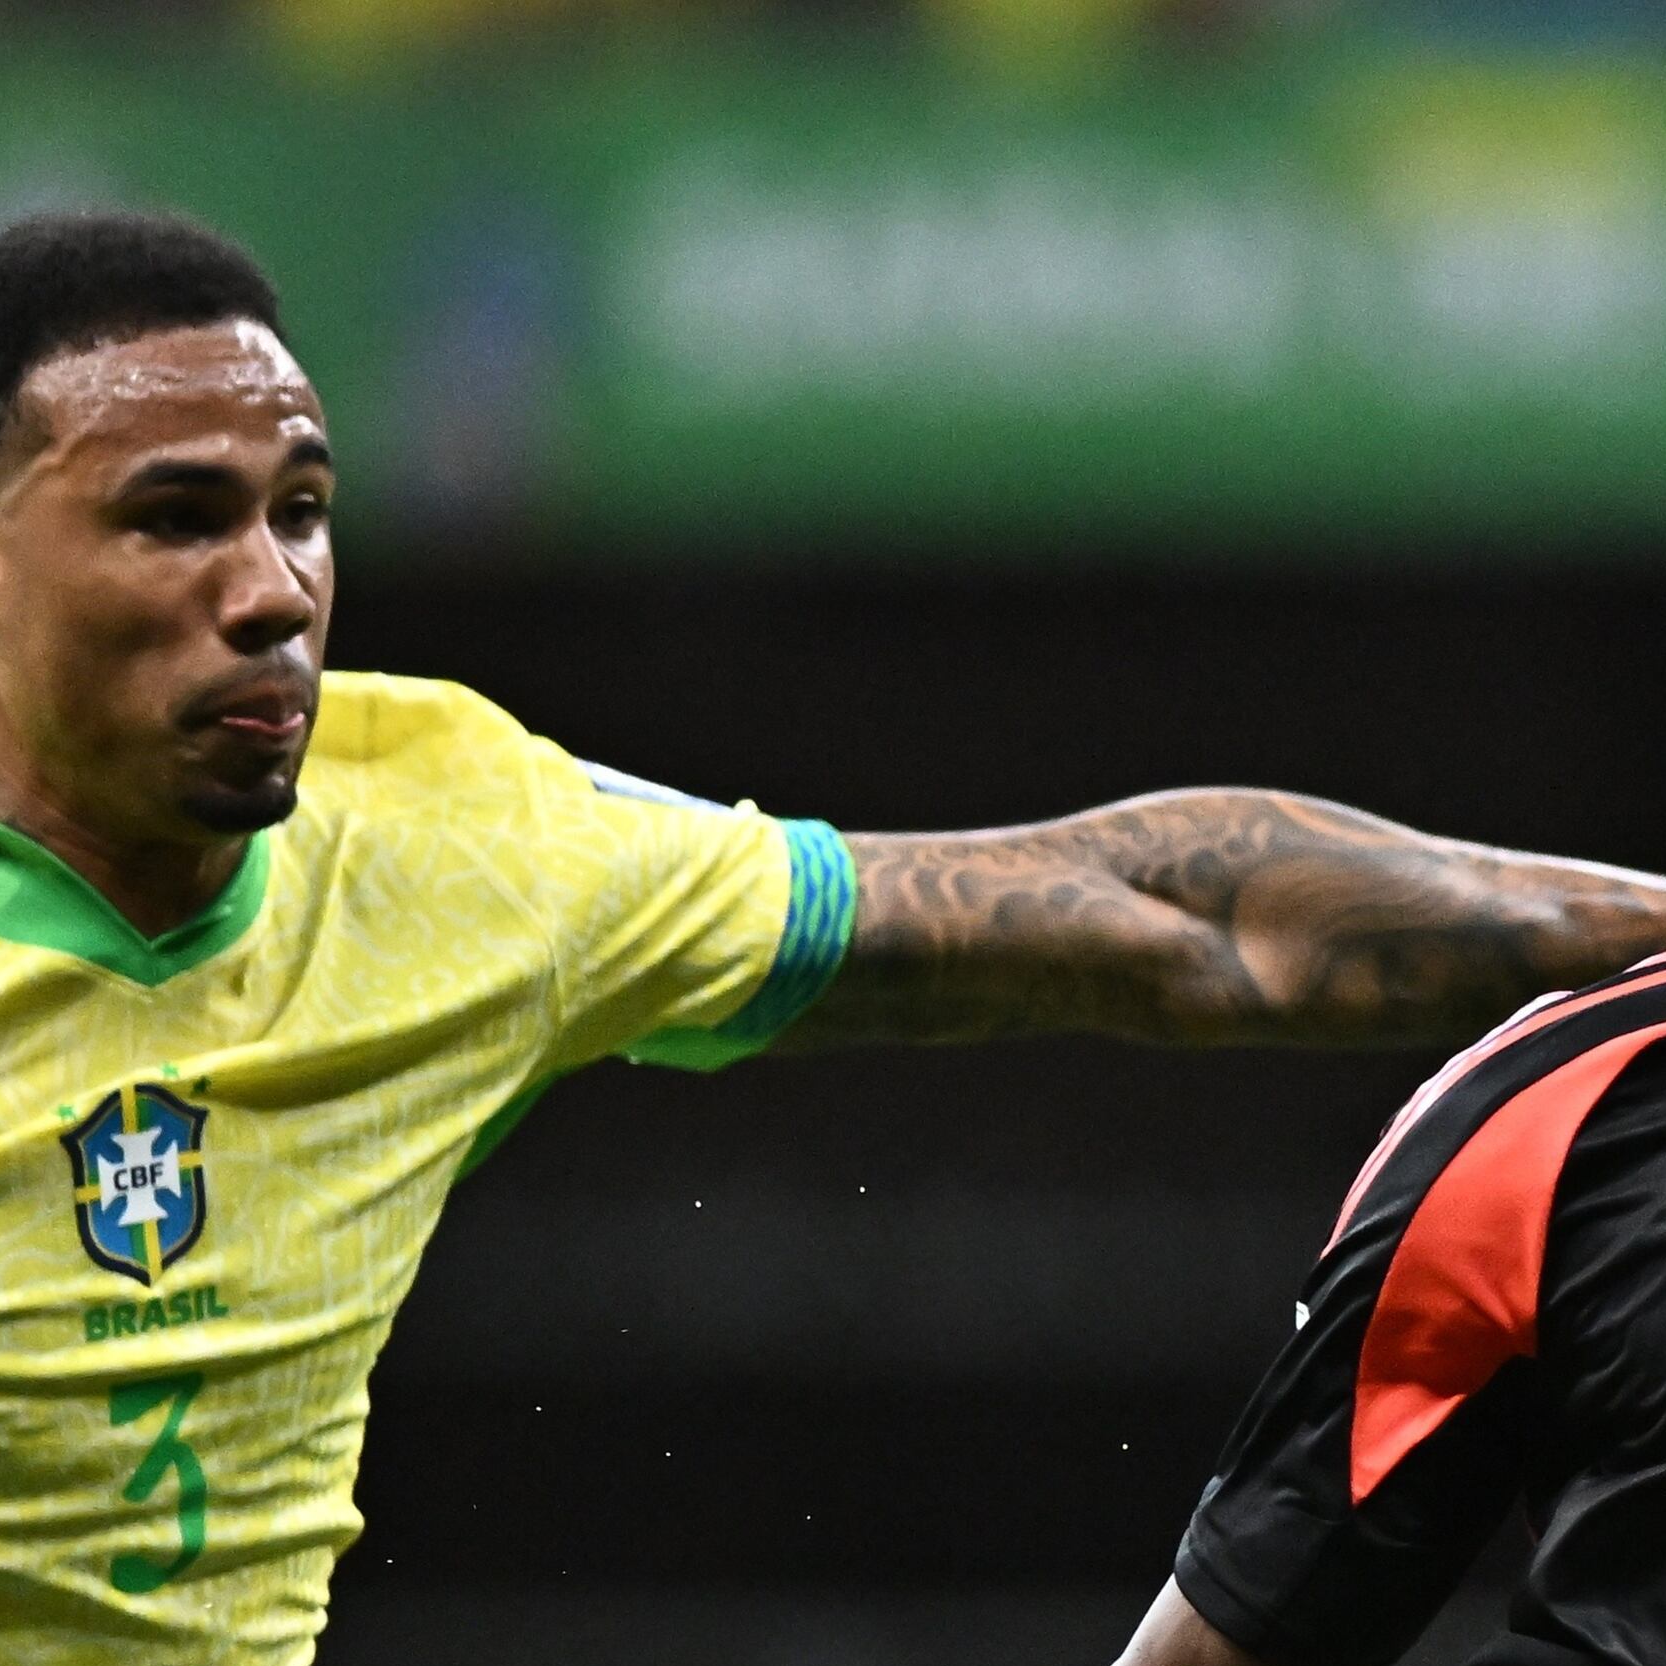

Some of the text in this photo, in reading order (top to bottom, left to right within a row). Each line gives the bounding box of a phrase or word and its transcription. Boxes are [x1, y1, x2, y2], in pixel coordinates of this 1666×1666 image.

[113, 1162, 165, 1195] CBF
[84, 1284, 229, 1343] BRASIL
[109, 1370, 207, 1594] 3
